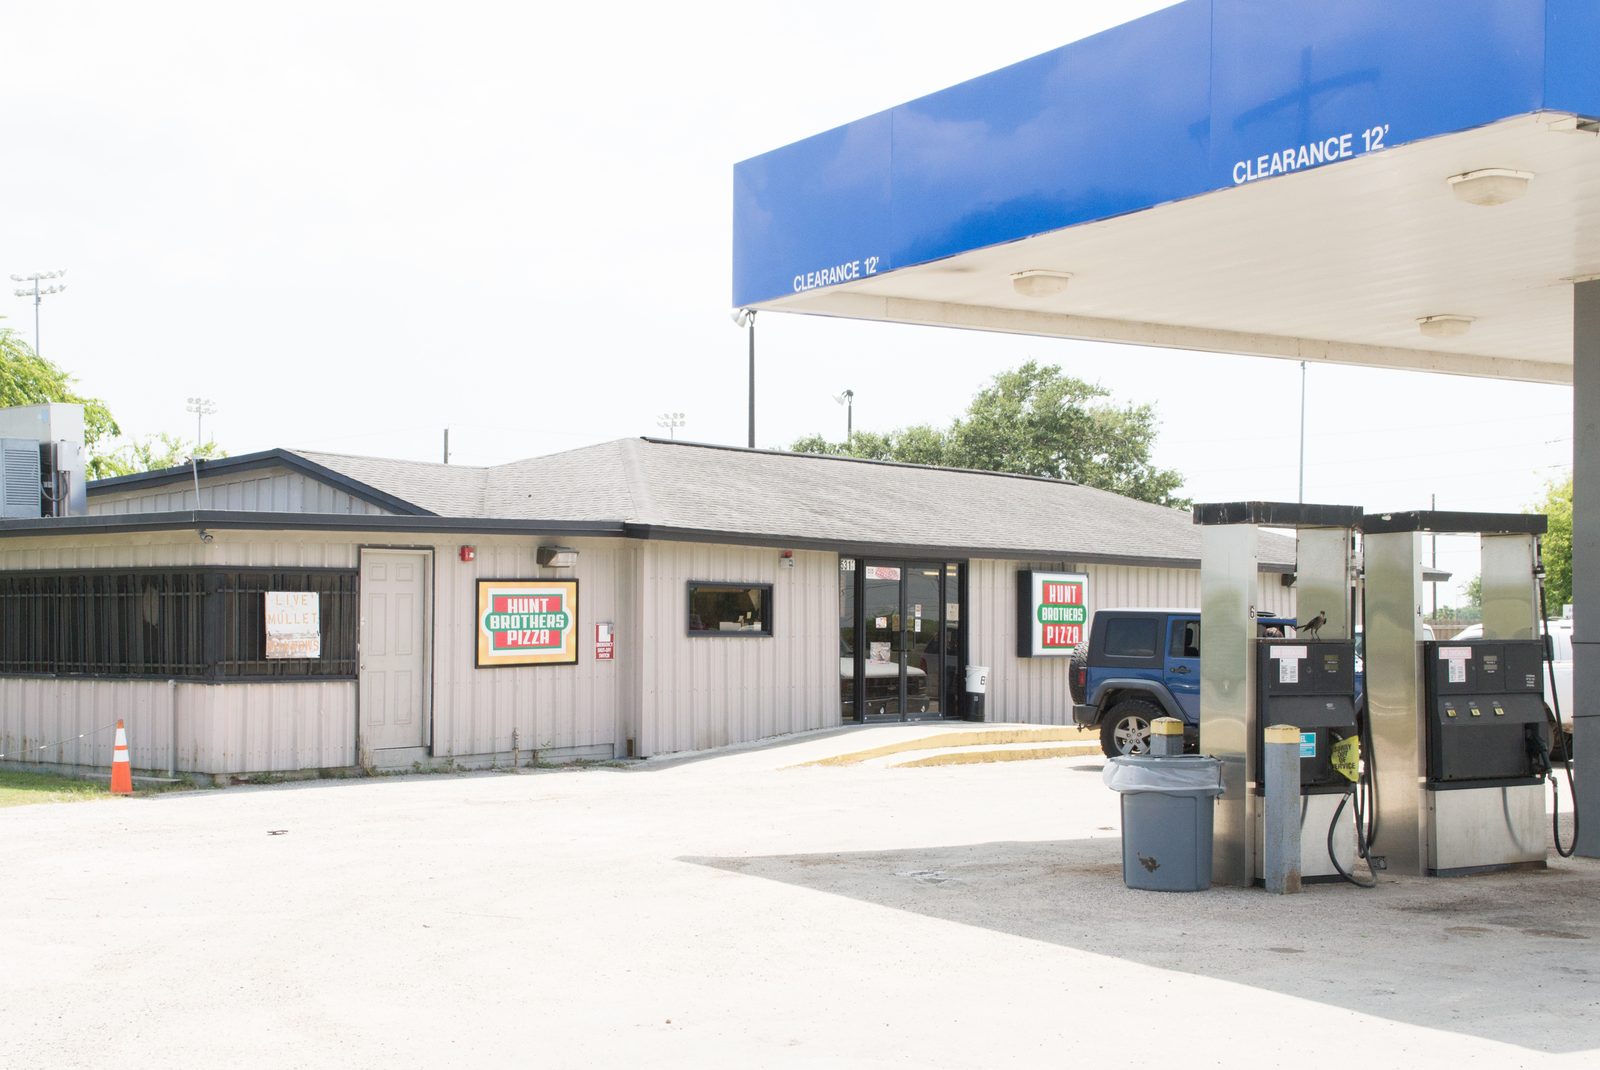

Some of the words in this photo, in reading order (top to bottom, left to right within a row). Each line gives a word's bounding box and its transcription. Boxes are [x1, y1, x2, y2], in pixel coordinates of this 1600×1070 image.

[1232, 133, 1353, 184] CLEARANCE
[1361, 124, 1389, 152] 12'
[793, 260, 860, 292] CLEARANCE
[864, 256, 880, 275] 12'
[275, 594, 308, 606] LIVE
[1049, 584, 1077, 603] HUNT
[507, 598, 550, 614] HUNT
[1250, 605, 1255, 618] 6
[268, 612, 317, 625] MULLET
[489, 614, 565, 629] BROTHERS
[1042, 607, 1084, 622] BROTHERS
[507, 629, 550, 645] PIZZA
[1046, 626, 1079, 644] PIZZA
